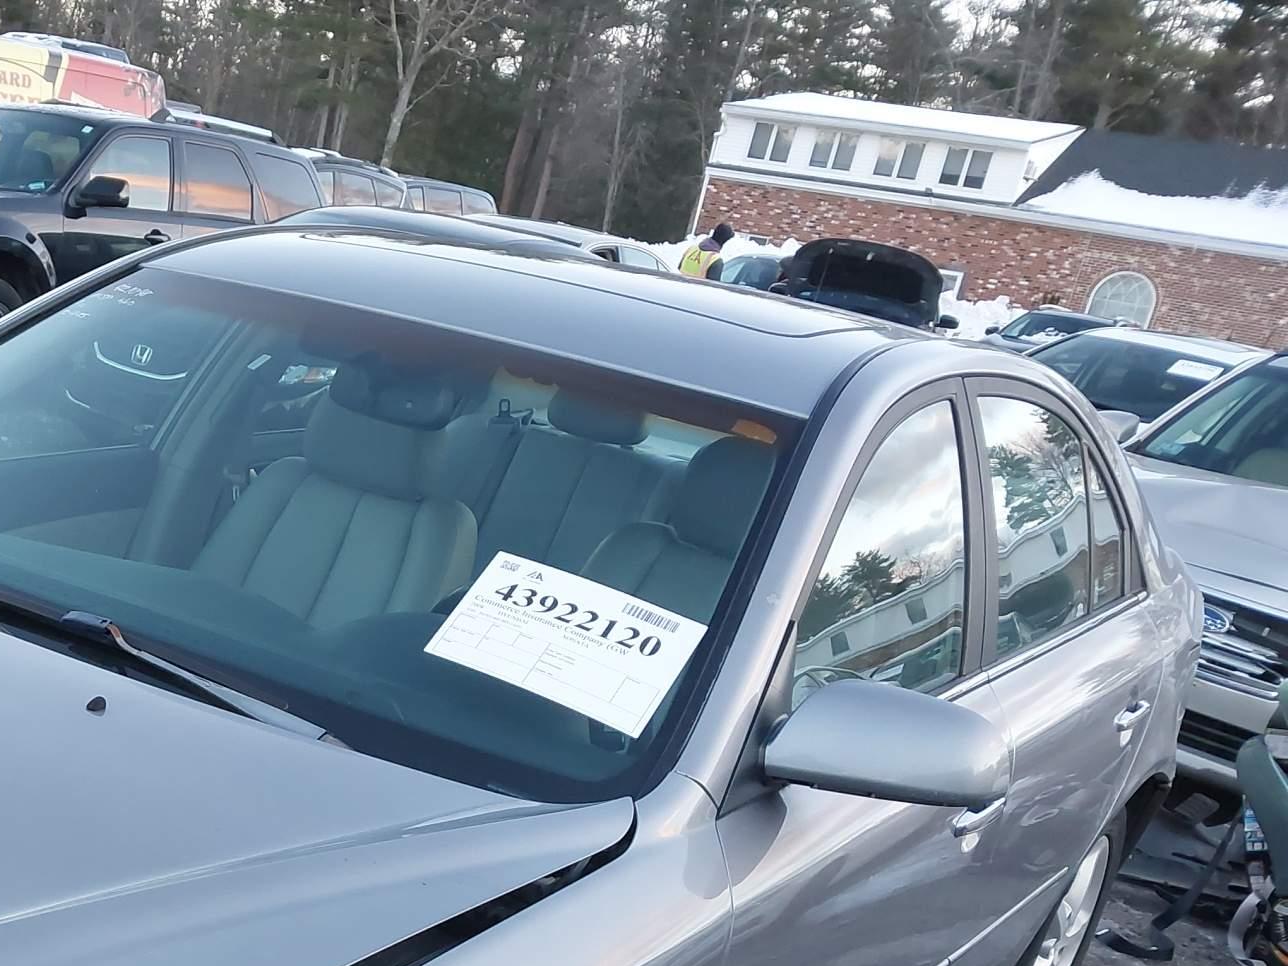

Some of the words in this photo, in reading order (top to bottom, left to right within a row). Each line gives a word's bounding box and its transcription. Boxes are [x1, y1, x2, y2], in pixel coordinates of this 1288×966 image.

[494, 583, 662, 657] 43922120
[521, 608, 562, 630] Insurance
[564, 625, 603, 647] Company
